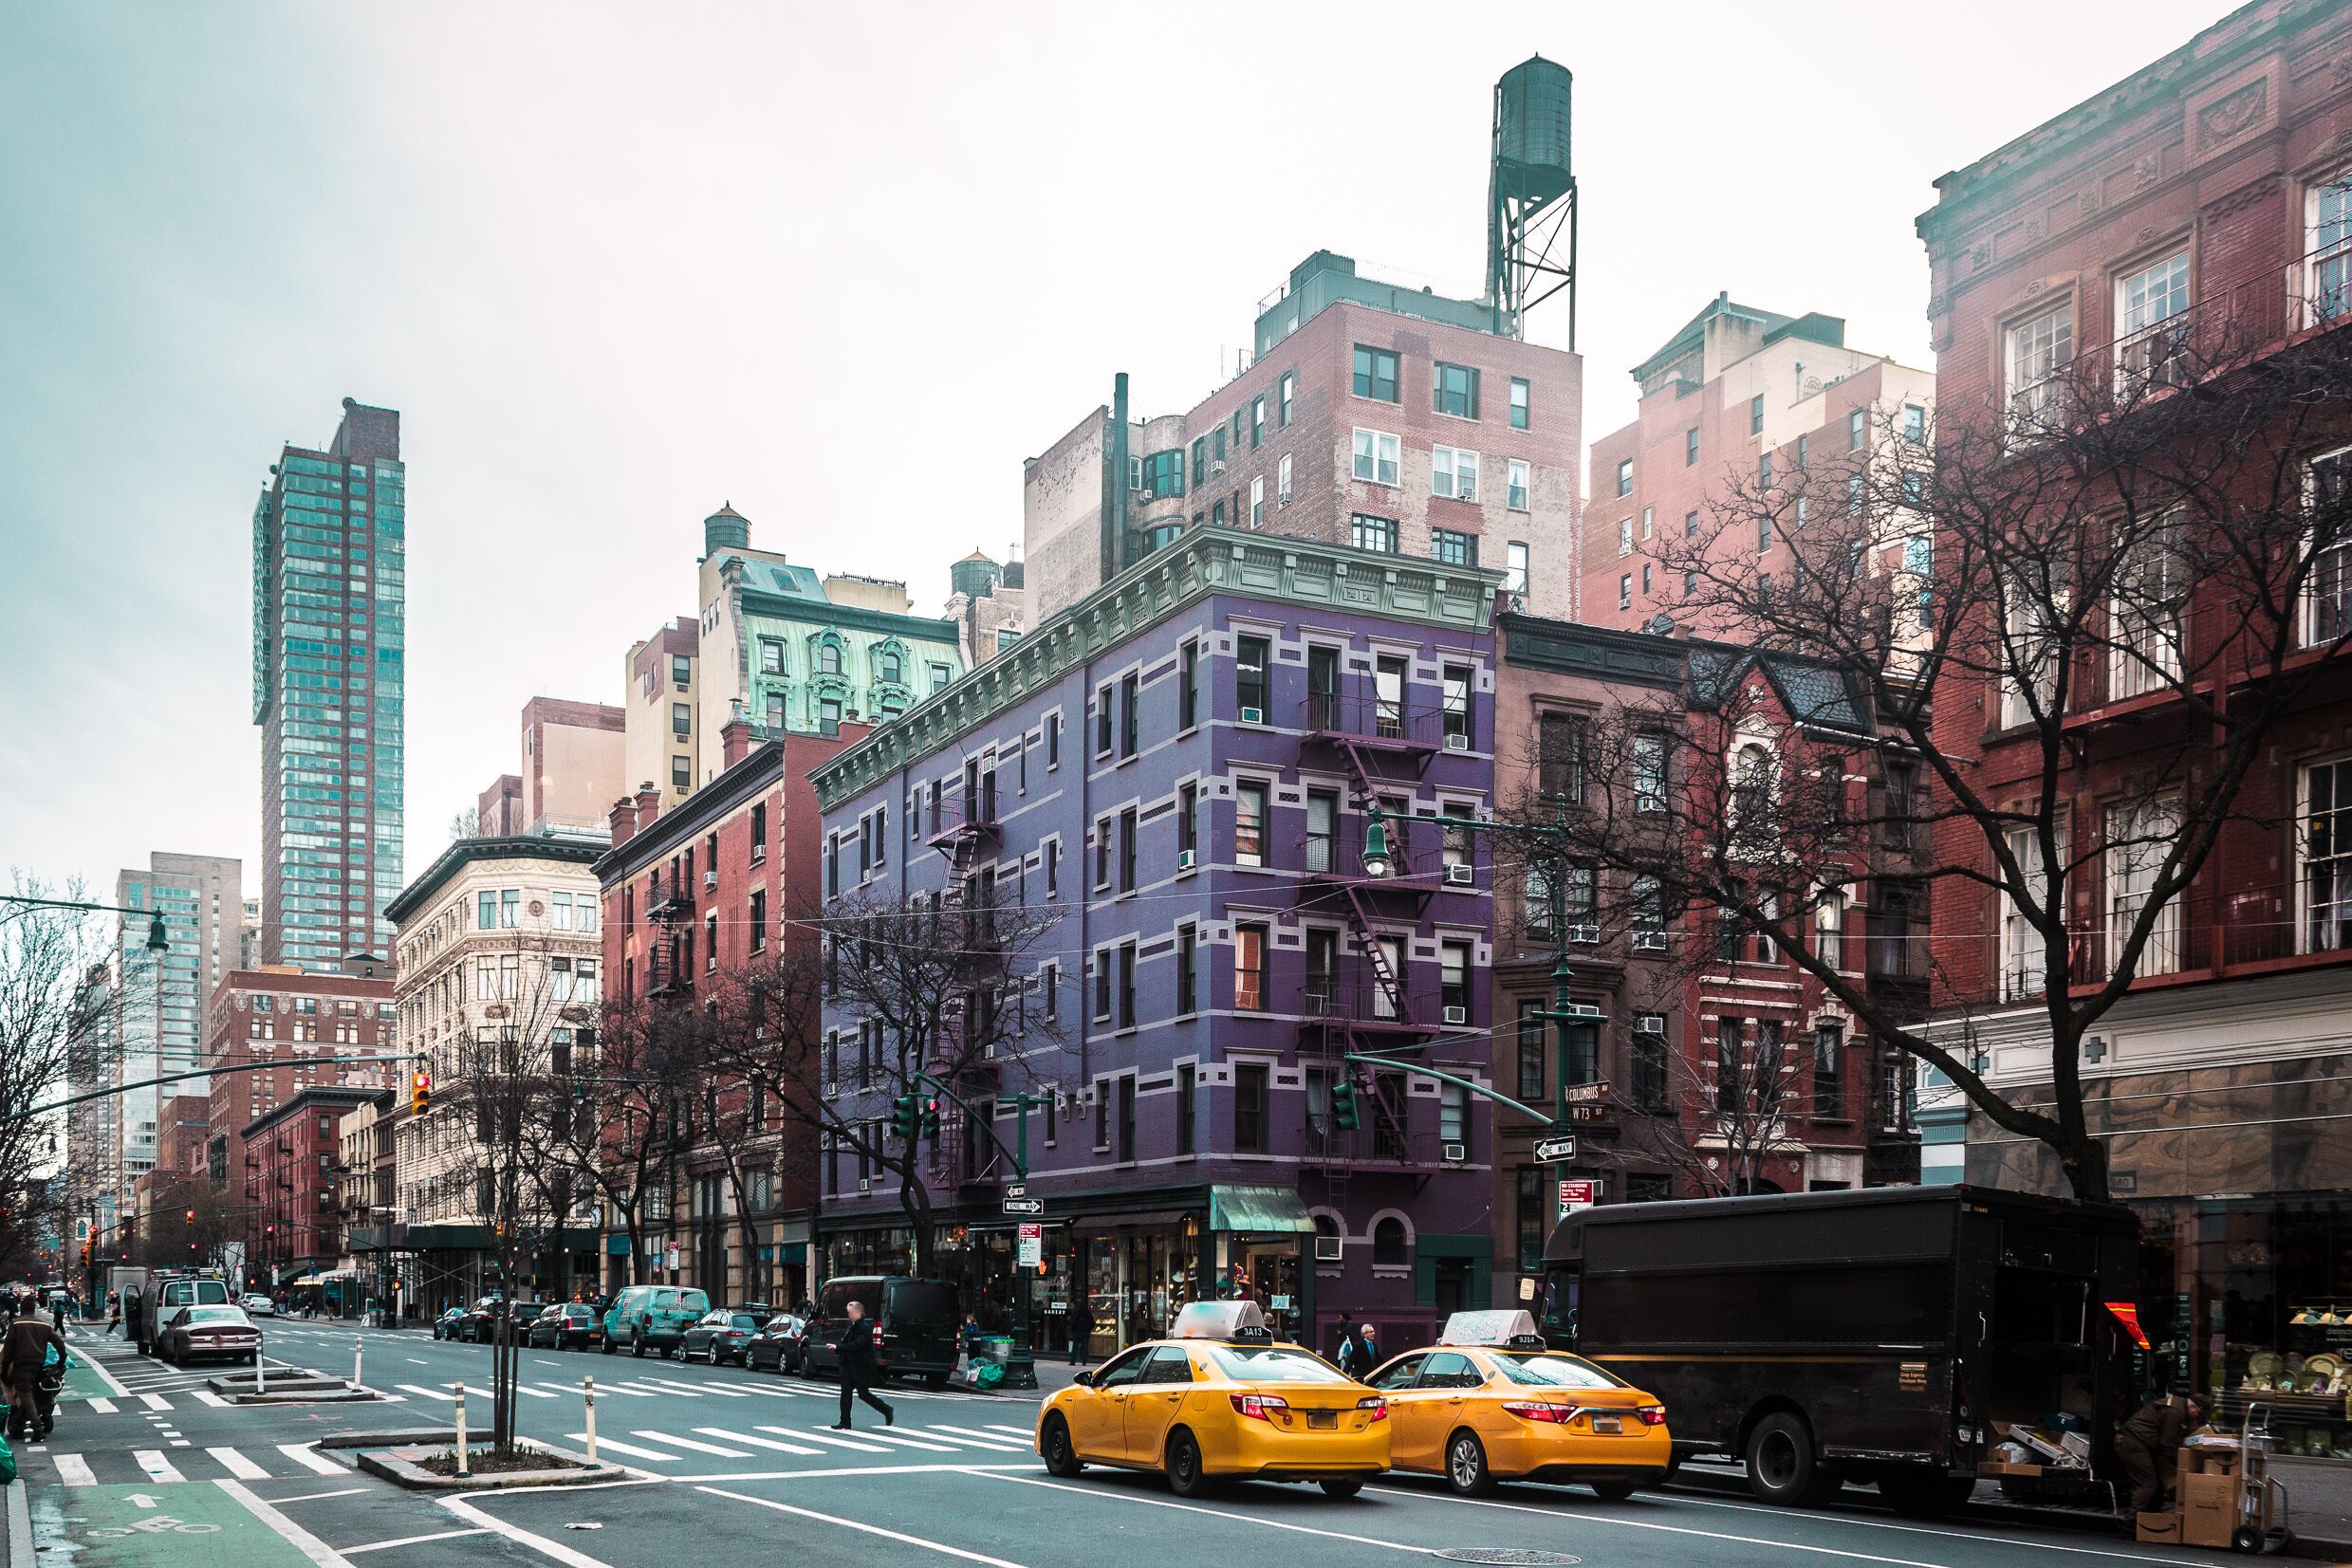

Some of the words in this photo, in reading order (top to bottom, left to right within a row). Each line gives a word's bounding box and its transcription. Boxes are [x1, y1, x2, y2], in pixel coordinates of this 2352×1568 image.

[1569, 1086, 1599, 1101] COLUMBUS
[1572, 1107, 1580, 1119] W
[1581, 1107, 1590, 1120] 73
[1540, 1146, 1553, 1155] ONE
[1558, 1143, 1570, 1153] WAY
[1562, 1203, 1568, 1212] 2
[1244, 1327, 1263, 1337] 3A13
